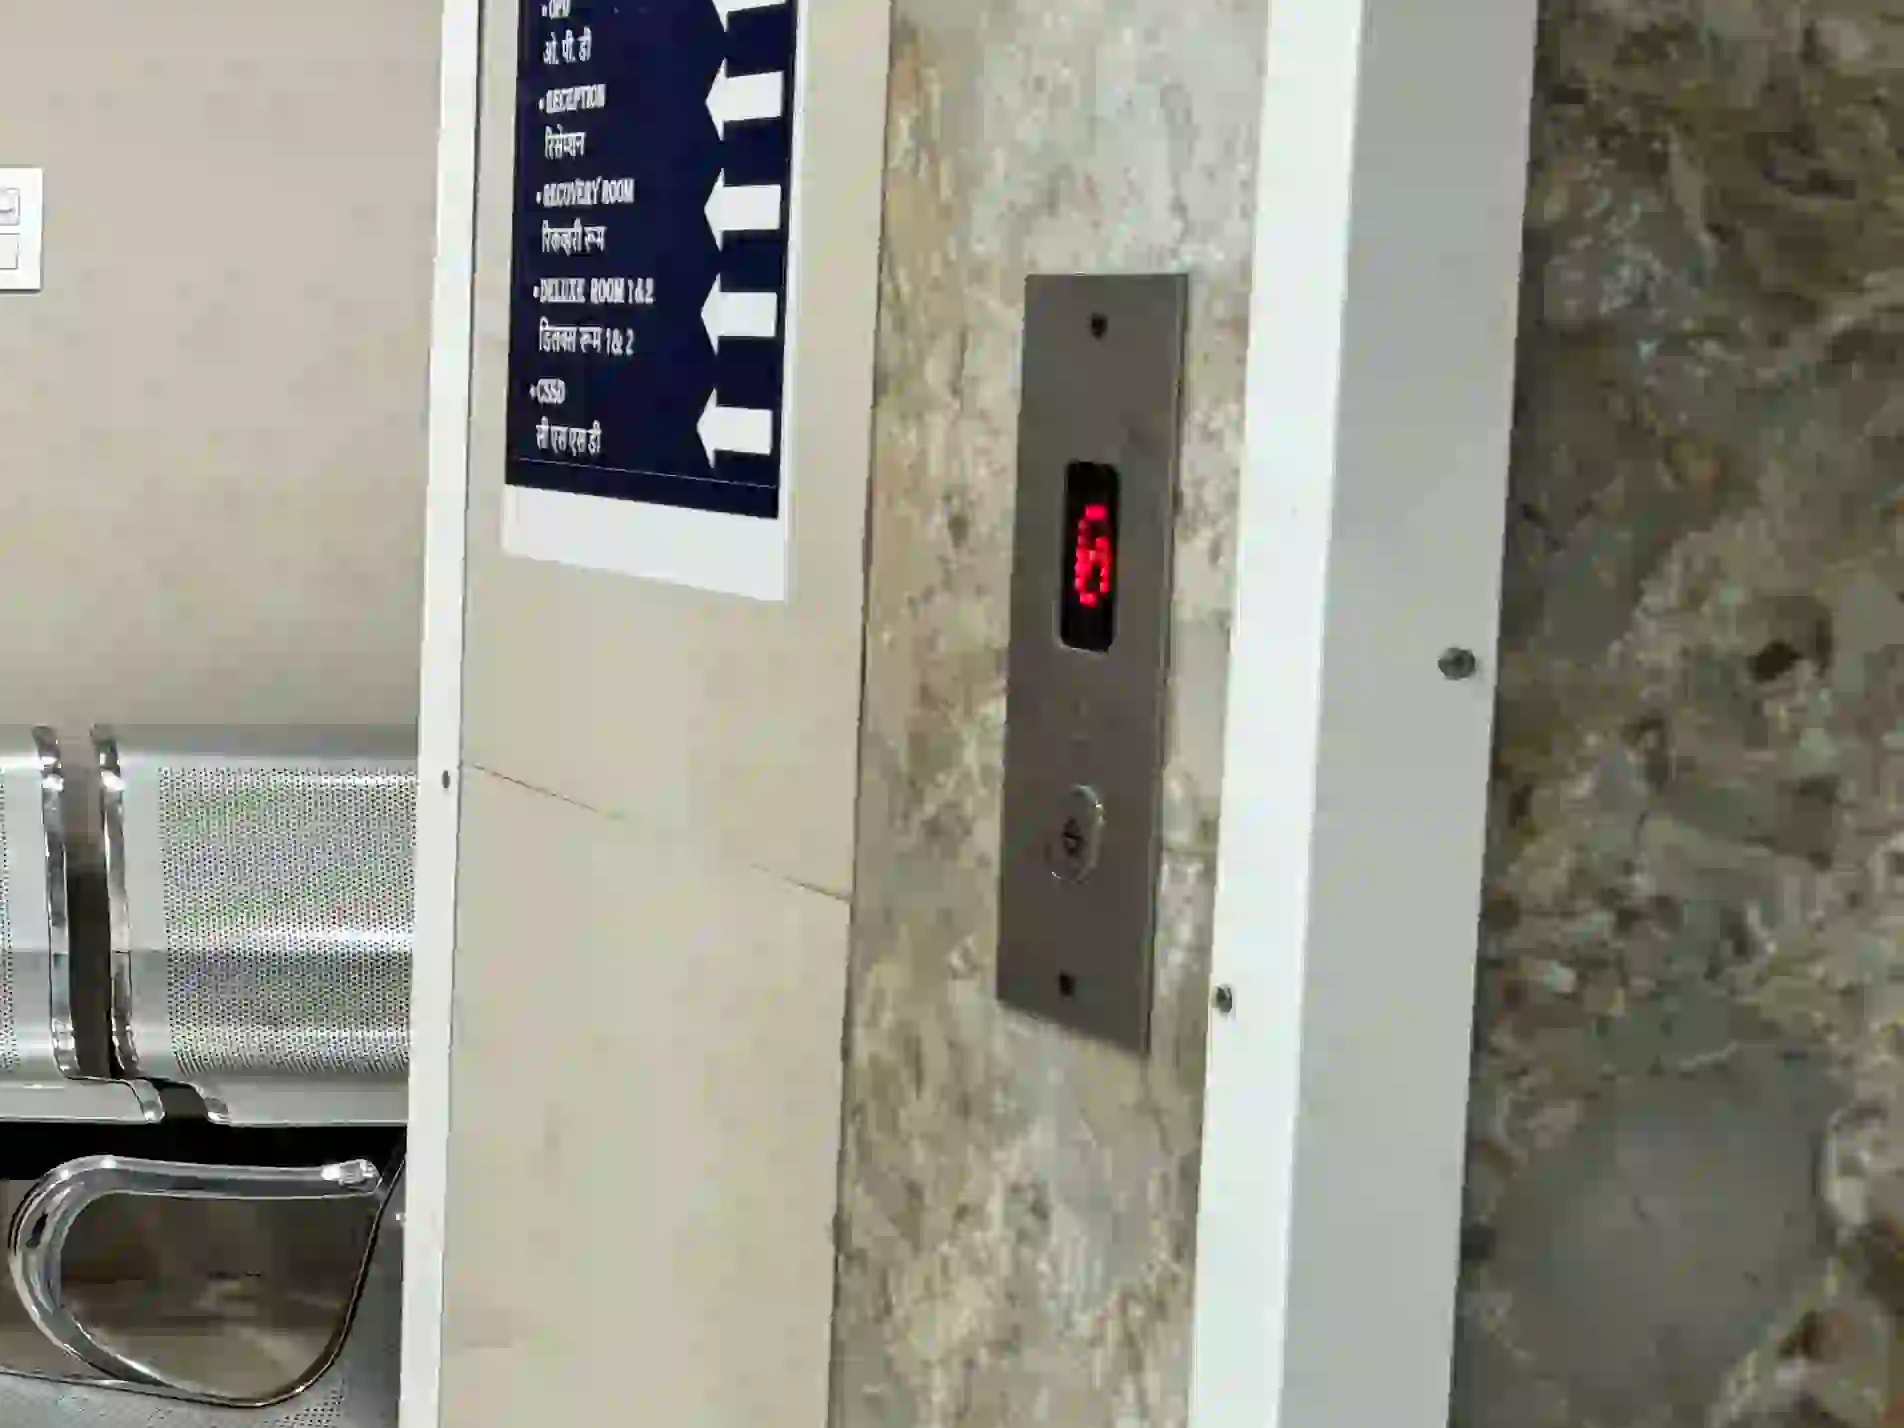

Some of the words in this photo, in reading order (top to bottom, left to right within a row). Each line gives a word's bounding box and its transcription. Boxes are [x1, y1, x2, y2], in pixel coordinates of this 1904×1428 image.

[545, 83, 606, 114] RECEPTION
[601, 177, 635, 205] ROOM
[590, 277, 625, 304] ROOM
[536, 377, 566, 404] CSSD
